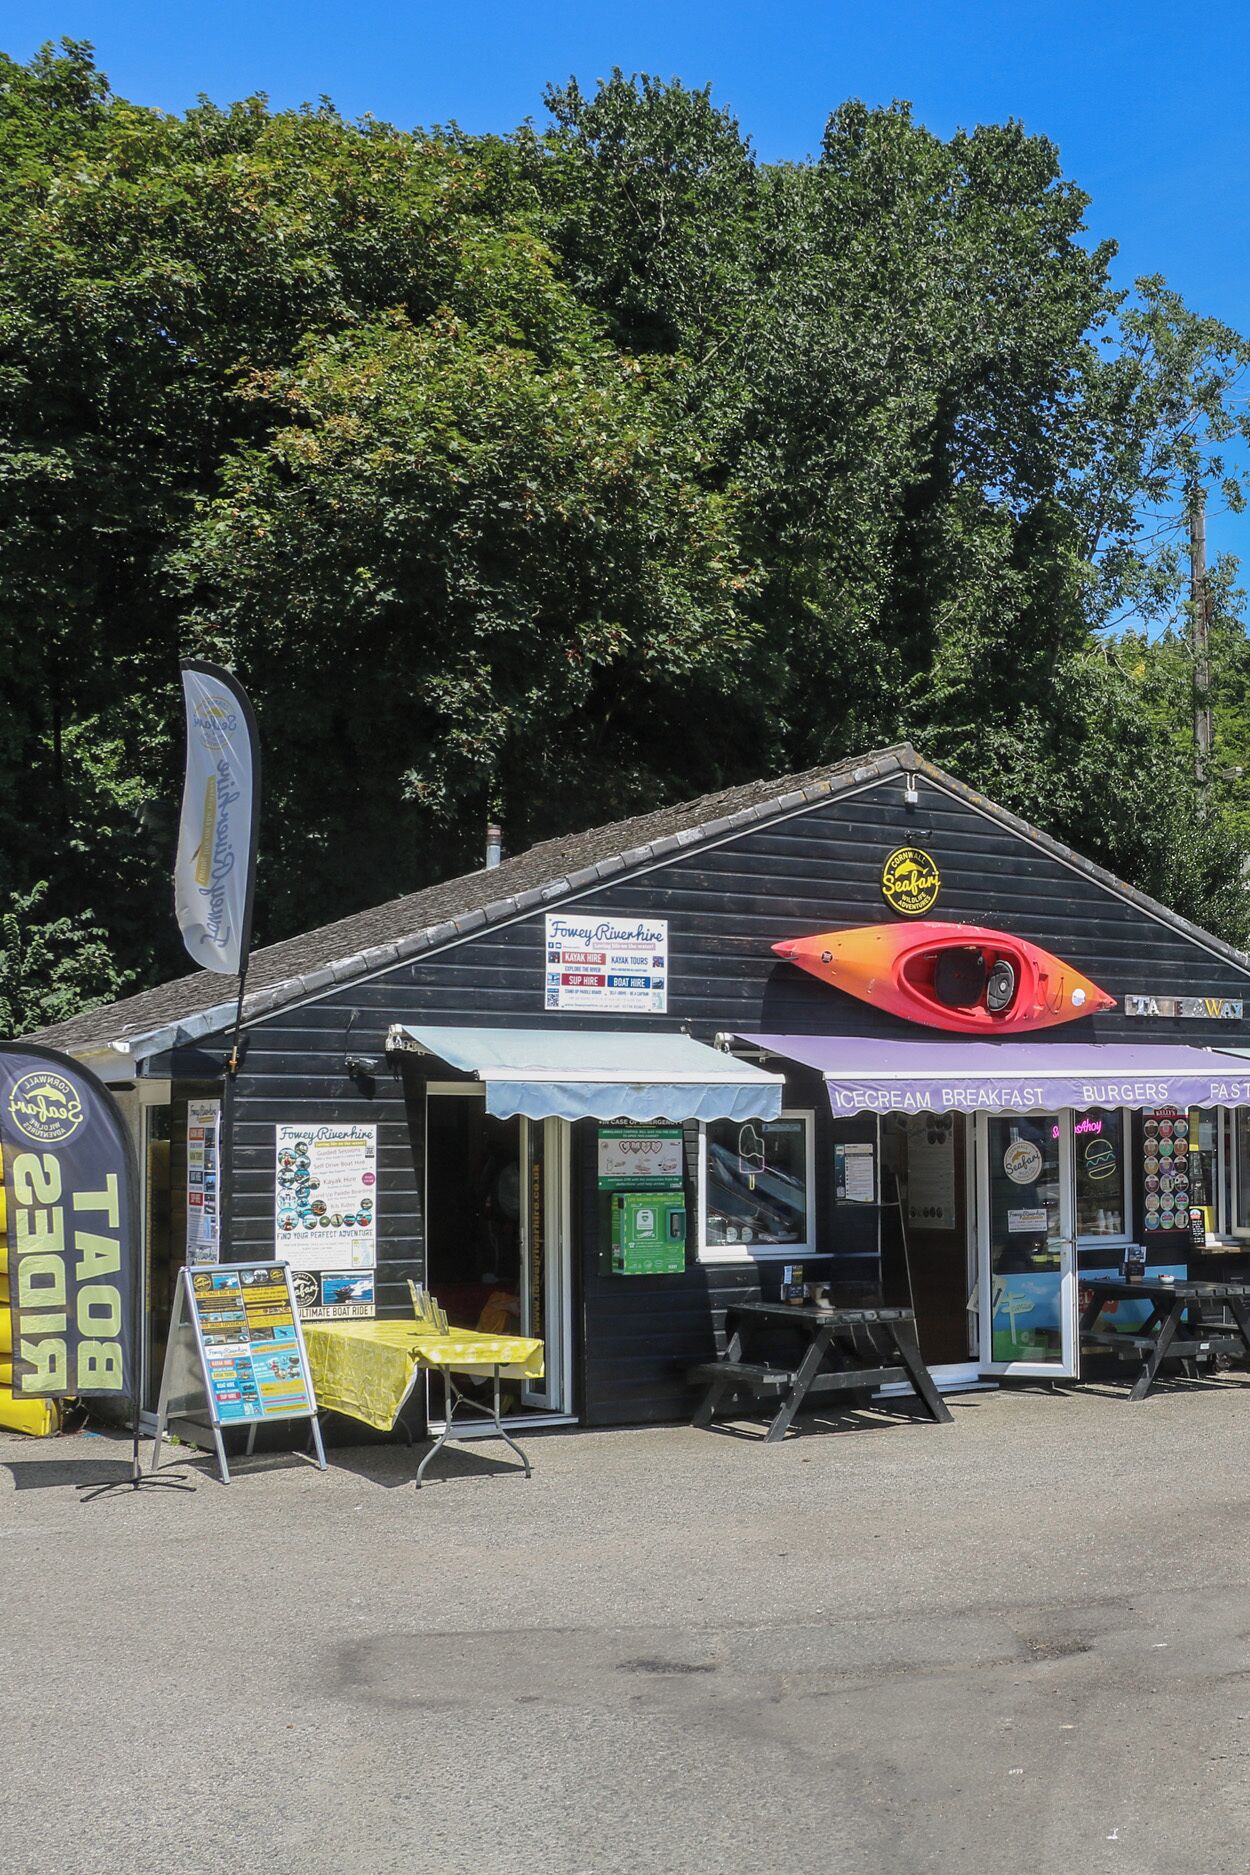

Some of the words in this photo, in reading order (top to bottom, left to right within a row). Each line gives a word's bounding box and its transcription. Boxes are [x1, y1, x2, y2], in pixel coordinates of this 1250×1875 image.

[891, 851, 926, 869] CORNWALL
[882, 870, 941, 895] Seafari
[902, 891, 926, 904] WILDLIFE
[550, 921, 596, 946] Fowey
[596, 923, 664, 942] Riverhire
[565, 953, 586, 962] KAYAK
[587, 954, 602, 963] HIRE
[611, 957, 629, 965] KAYAK
[630, 957, 648, 965] TOURS
[569, 976, 582, 985] SUP
[583, 977, 598, 986] HIRE
[613, 978, 630, 987] BOAT
[630, 978, 646, 988] HIRE
[835, 1090, 932, 1108] ICECREAM
[942, 1088, 1044, 1106] BREAKFAST
[1083, 1083, 1168, 1101] BURGERS
[280, 1126, 315, 1145] Fowey
[315, 1126, 374, 1140] Riverhire
[1006, 1150, 1040, 1175] Seafari
[338, 1229, 373, 1237] ADVENTURE
[333, 1307, 350, 1316] BOAT
[352, 1305, 368, 1315] RIDE
